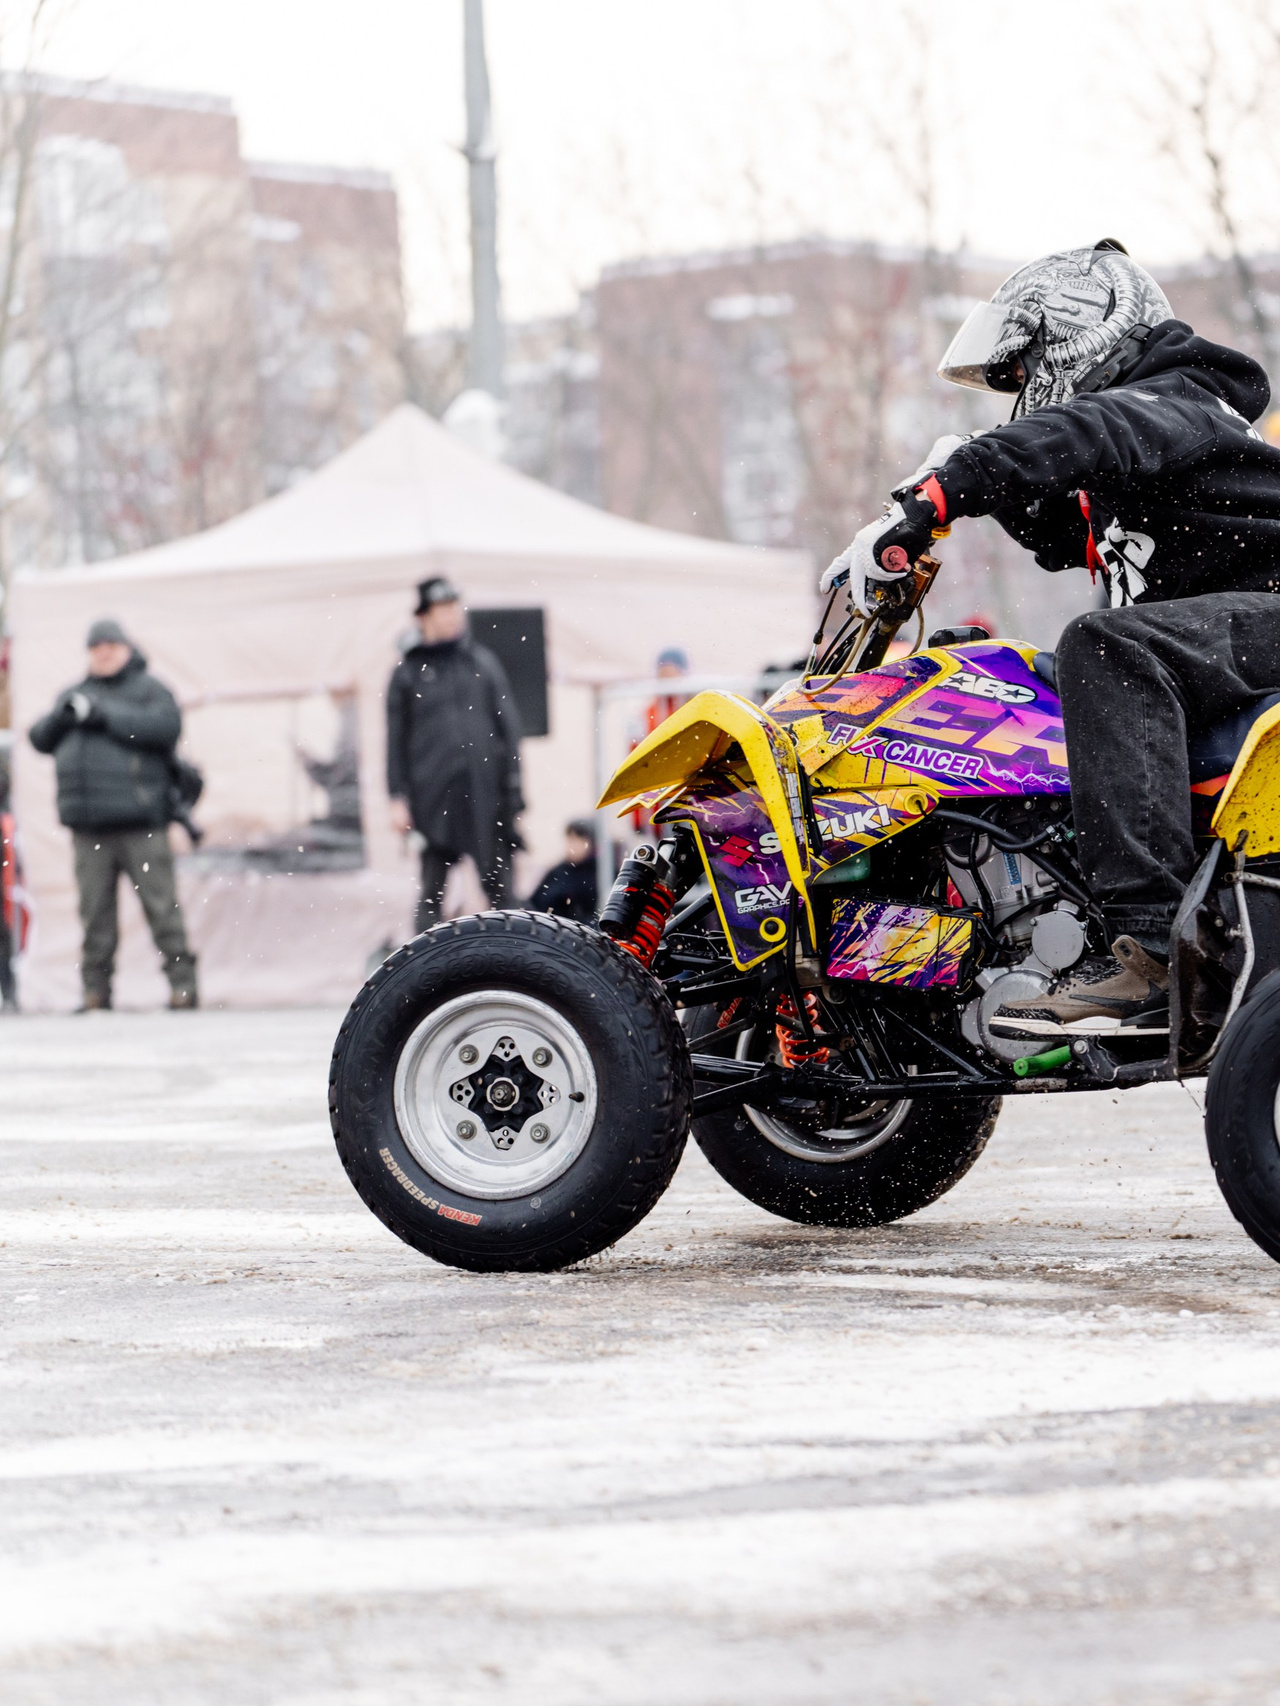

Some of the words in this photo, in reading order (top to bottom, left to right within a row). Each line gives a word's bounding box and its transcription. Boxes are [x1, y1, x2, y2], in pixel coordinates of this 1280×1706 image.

[883, 740, 984, 779] CANCER
[759, 804, 892, 854] SZUKI
[734, 880, 792, 907] GAV
[379, 1147, 440, 1214] SPEEDRACER
[438, 1203, 483, 1226] KENDA
